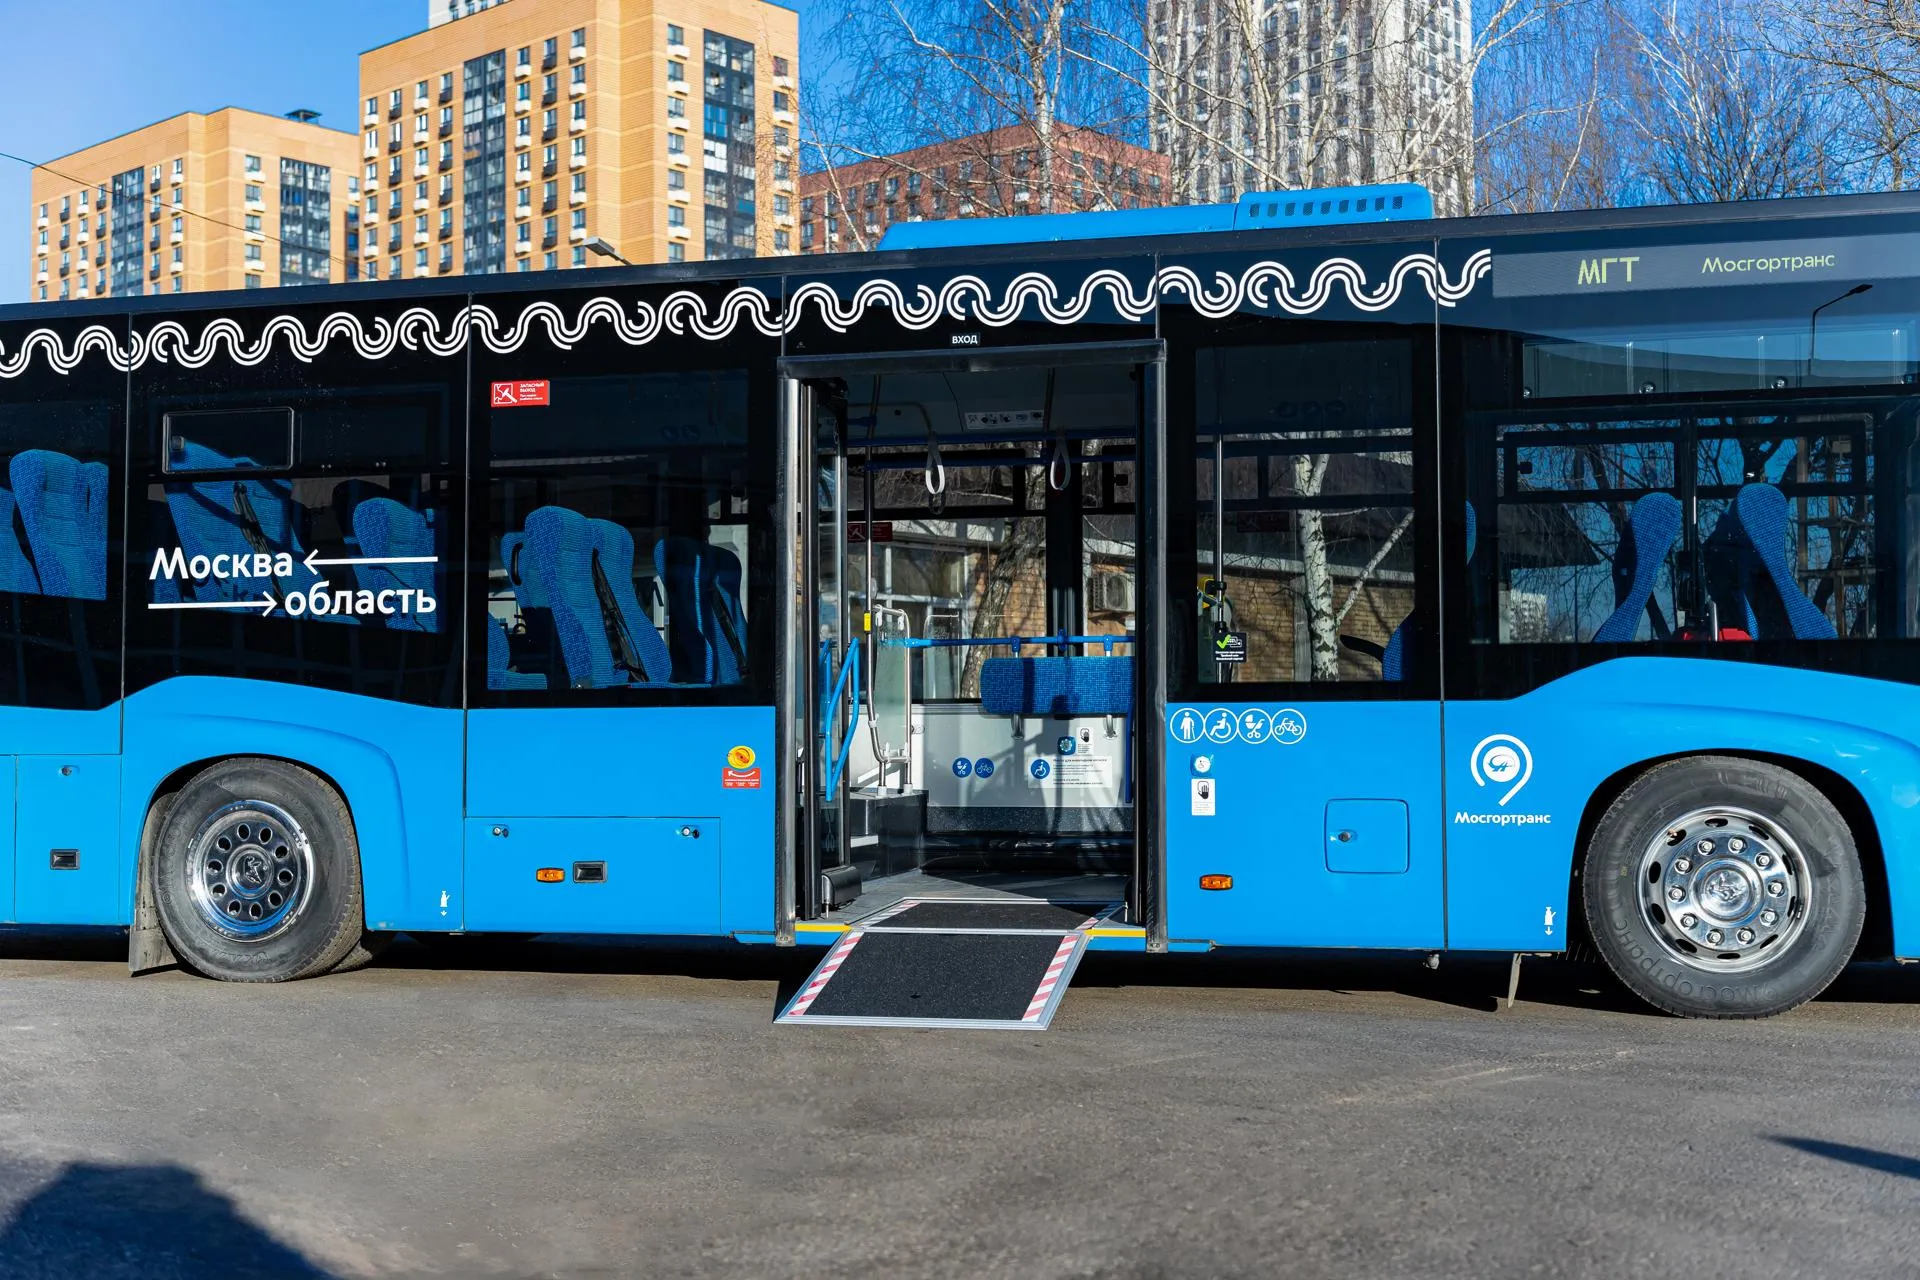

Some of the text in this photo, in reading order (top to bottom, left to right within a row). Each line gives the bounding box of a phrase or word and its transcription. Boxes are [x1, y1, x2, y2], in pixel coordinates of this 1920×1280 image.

[1577, 254, 1836, 285] МГТ Мосгортранс
[951, 335, 978, 345] ВХОД
[149, 547, 293, 580] Москва
[284, 580, 437, 616] область
[1454, 811, 1552, 827] Мосгортранс
